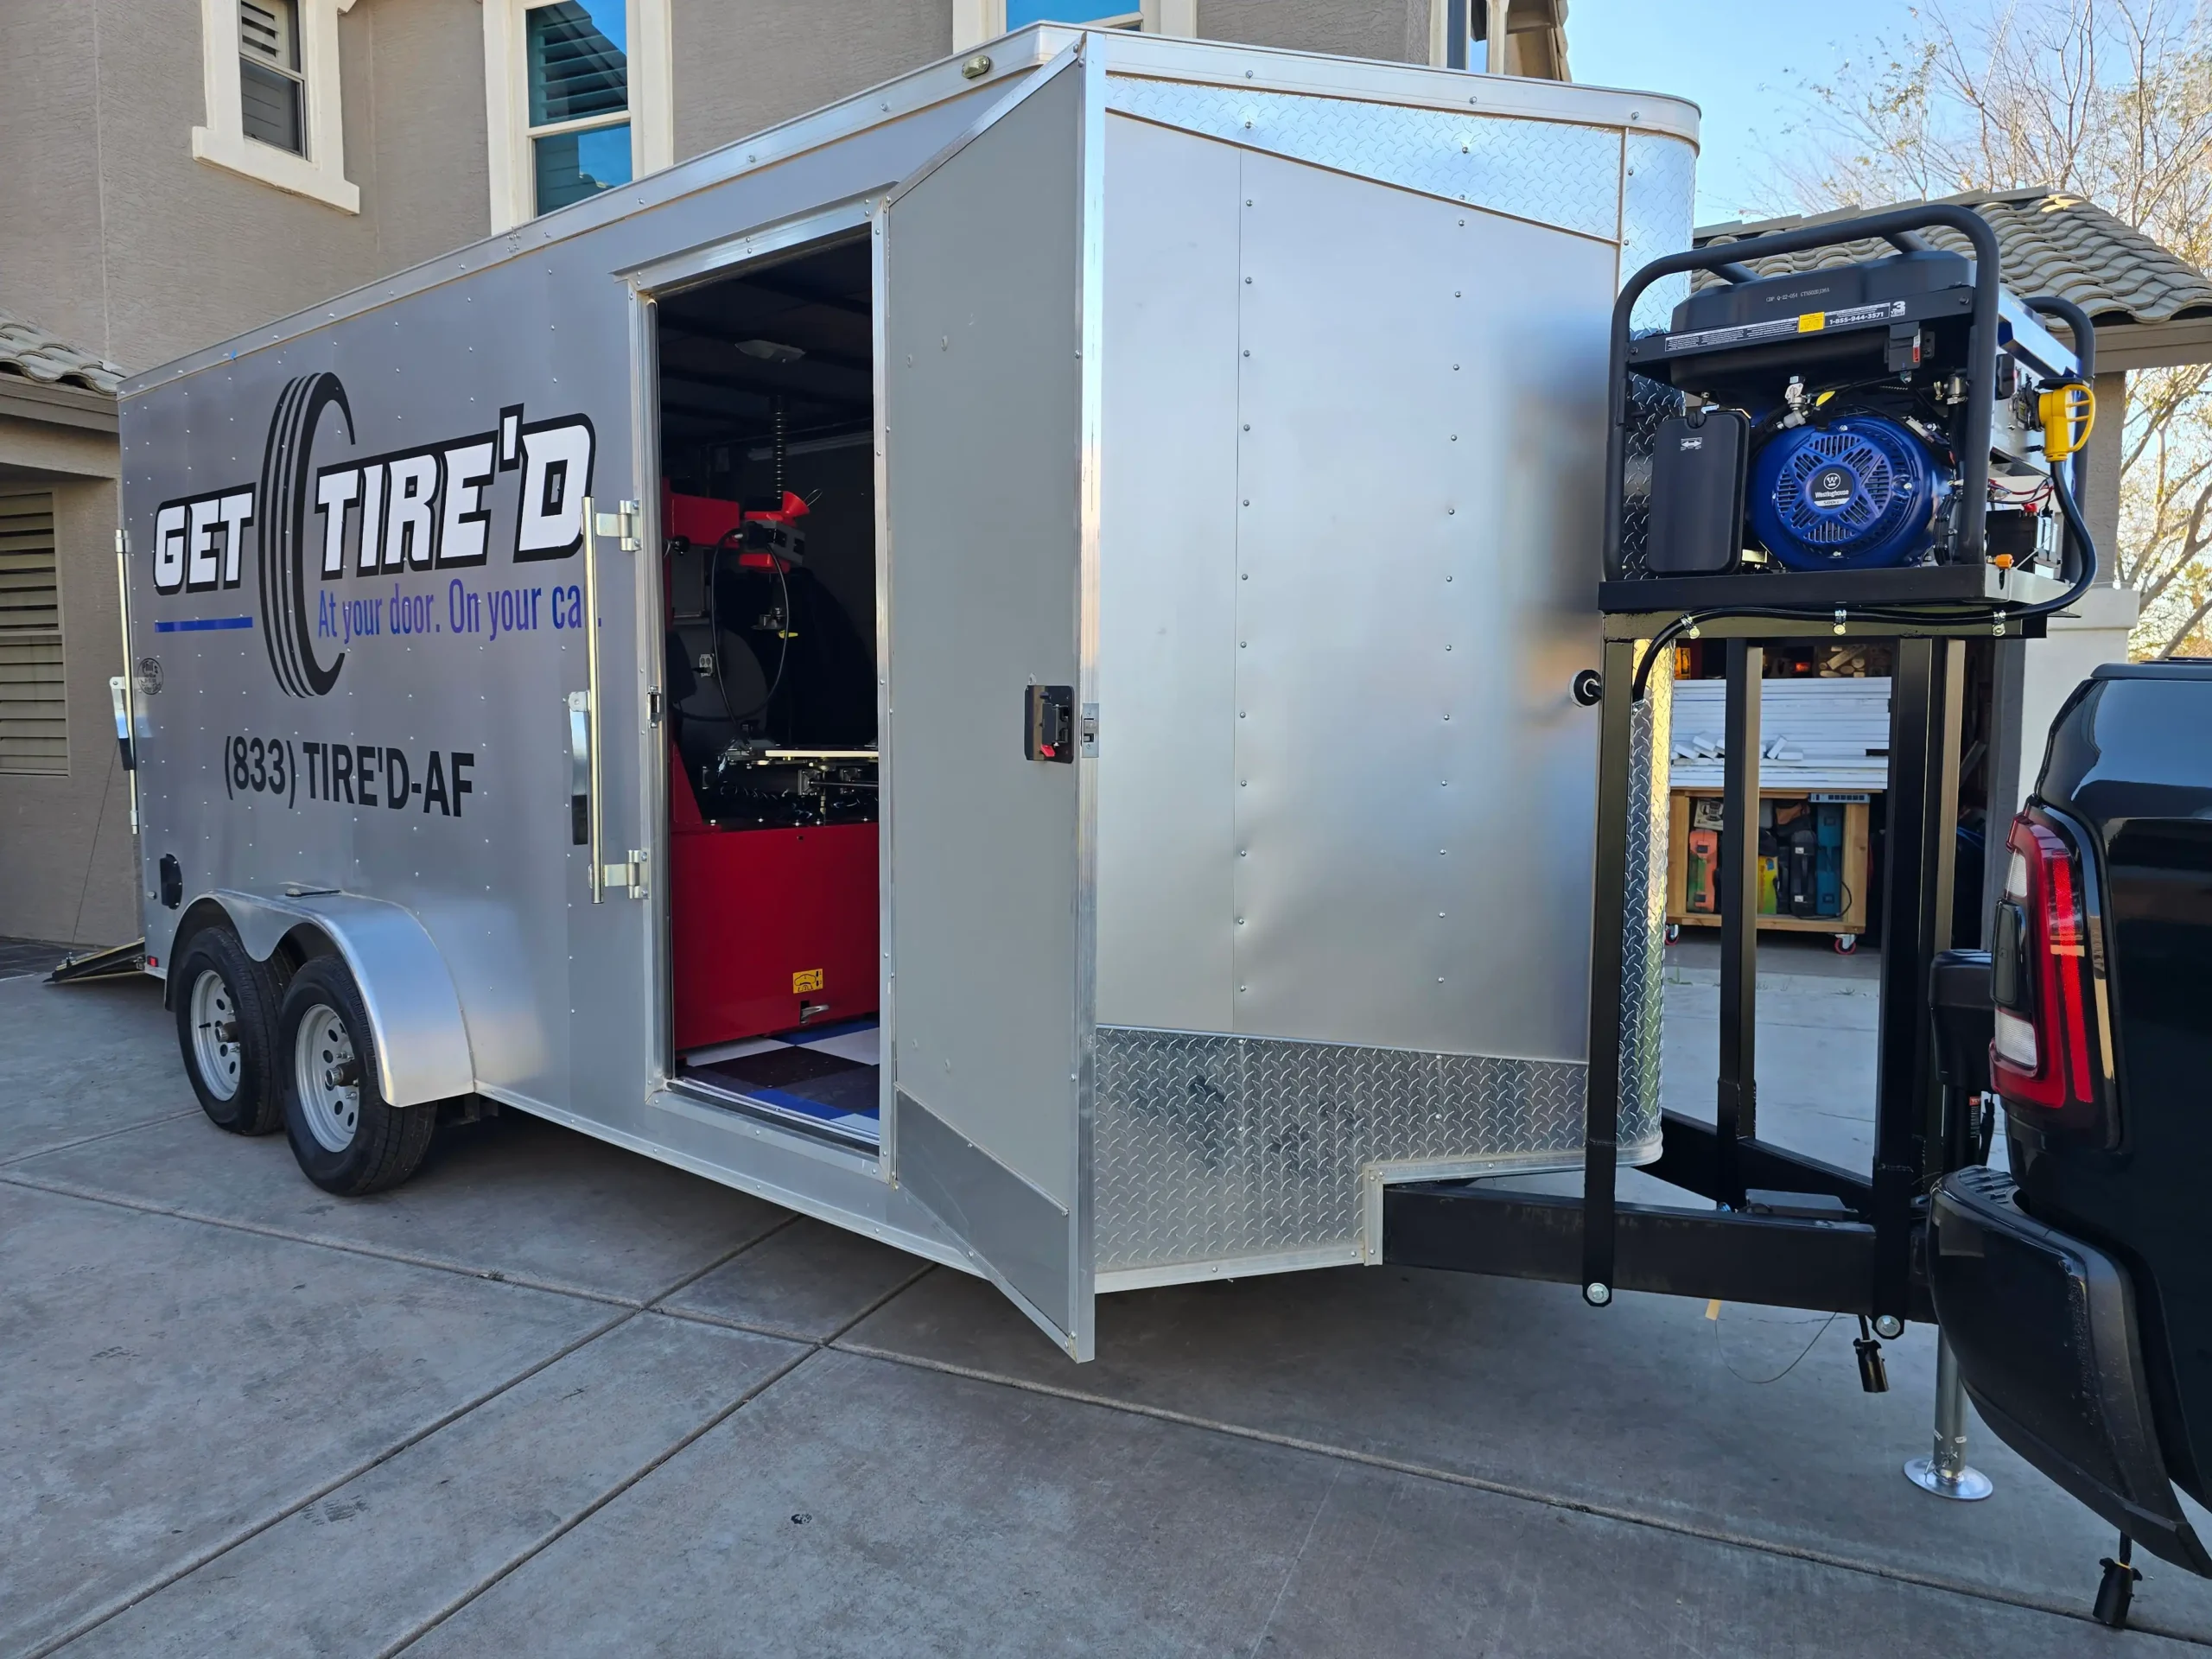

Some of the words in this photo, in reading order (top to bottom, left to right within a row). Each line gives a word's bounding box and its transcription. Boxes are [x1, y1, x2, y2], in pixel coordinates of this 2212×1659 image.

[1829, 311, 1885, 325] 1-855-944-3571
[153, 482, 257, 596] GET
[315, 403, 596, 581] TIRE'D
[318, 589, 338, 639] At
[343, 597, 383, 645] your
[390, 582, 441, 634] door.
[449, 578, 480, 634] On
[487, 588, 542, 641] your
[551, 584, 602, 630] ca.
[225, 735, 296, 809] (833)
[302, 741, 474, 817] TIRE'D-AF
